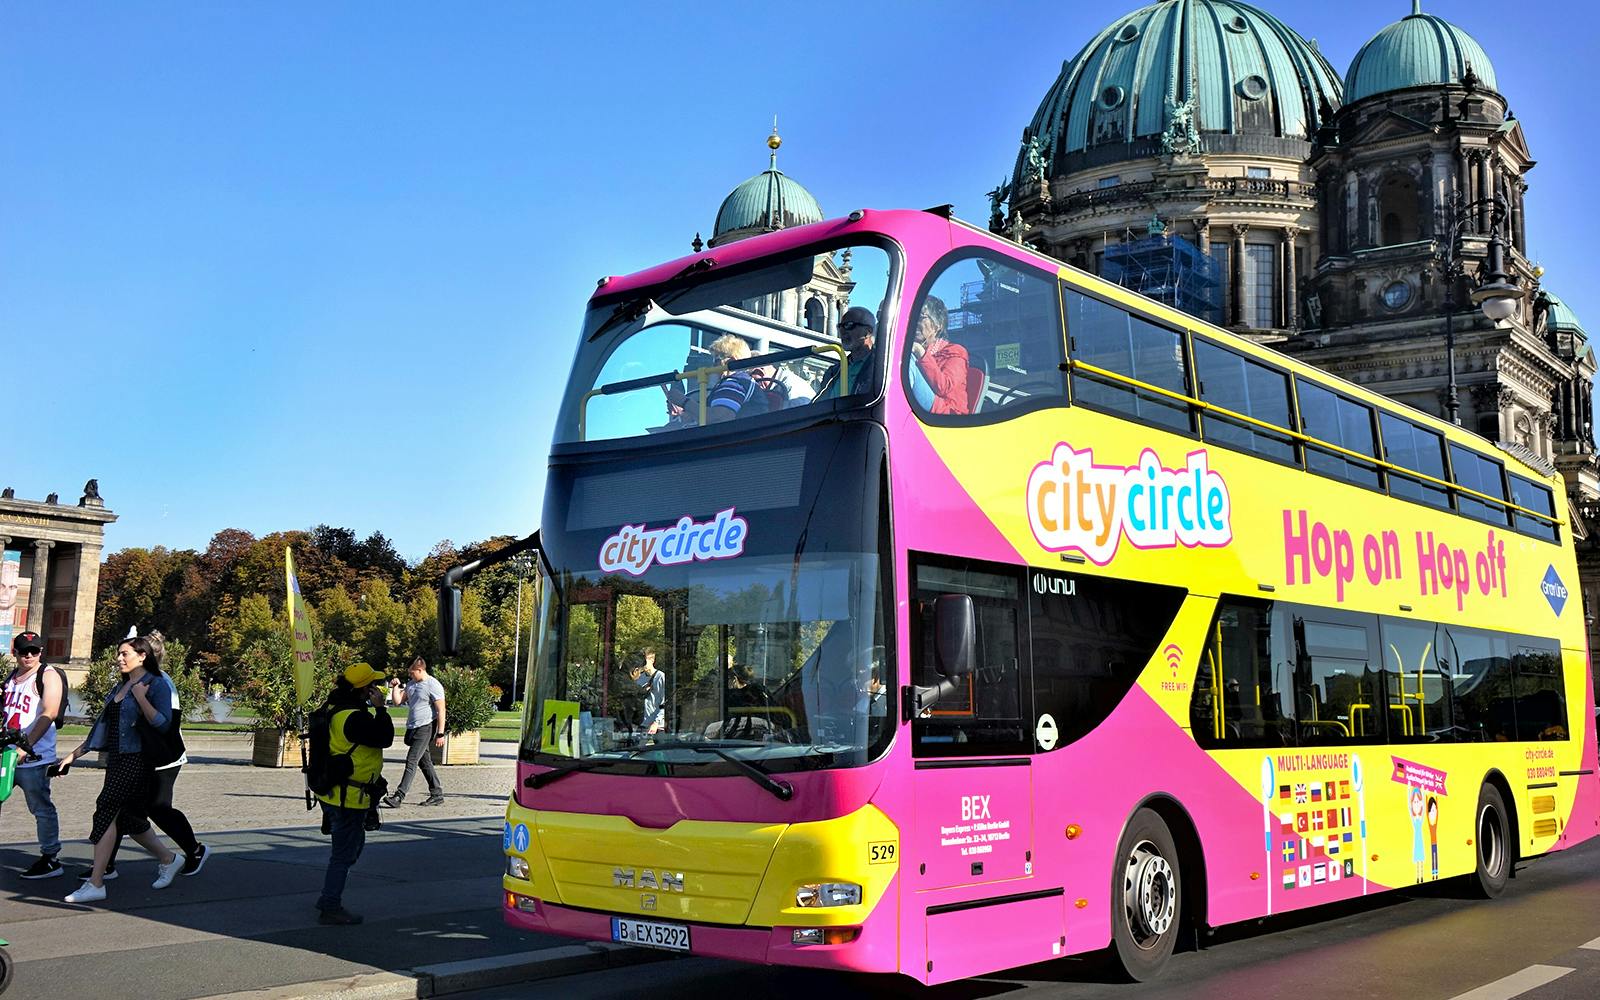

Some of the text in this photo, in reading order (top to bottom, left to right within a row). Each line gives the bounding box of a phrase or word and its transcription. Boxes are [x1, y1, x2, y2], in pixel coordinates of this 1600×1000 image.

[1037, 460, 1224, 547] city circle
[604, 517, 742, 569] city circle
[1283, 509, 1507, 611] Hop on Hop off
[1161, 681, 1174, 691] FREE
[3, 692, 31, 714] ULLS
[961, 794, 991, 821] BEX
[872, 845, 895, 860] 529
[612, 867, 684, 892] MAN
[620, 922, 688, 947] B EX 5292
